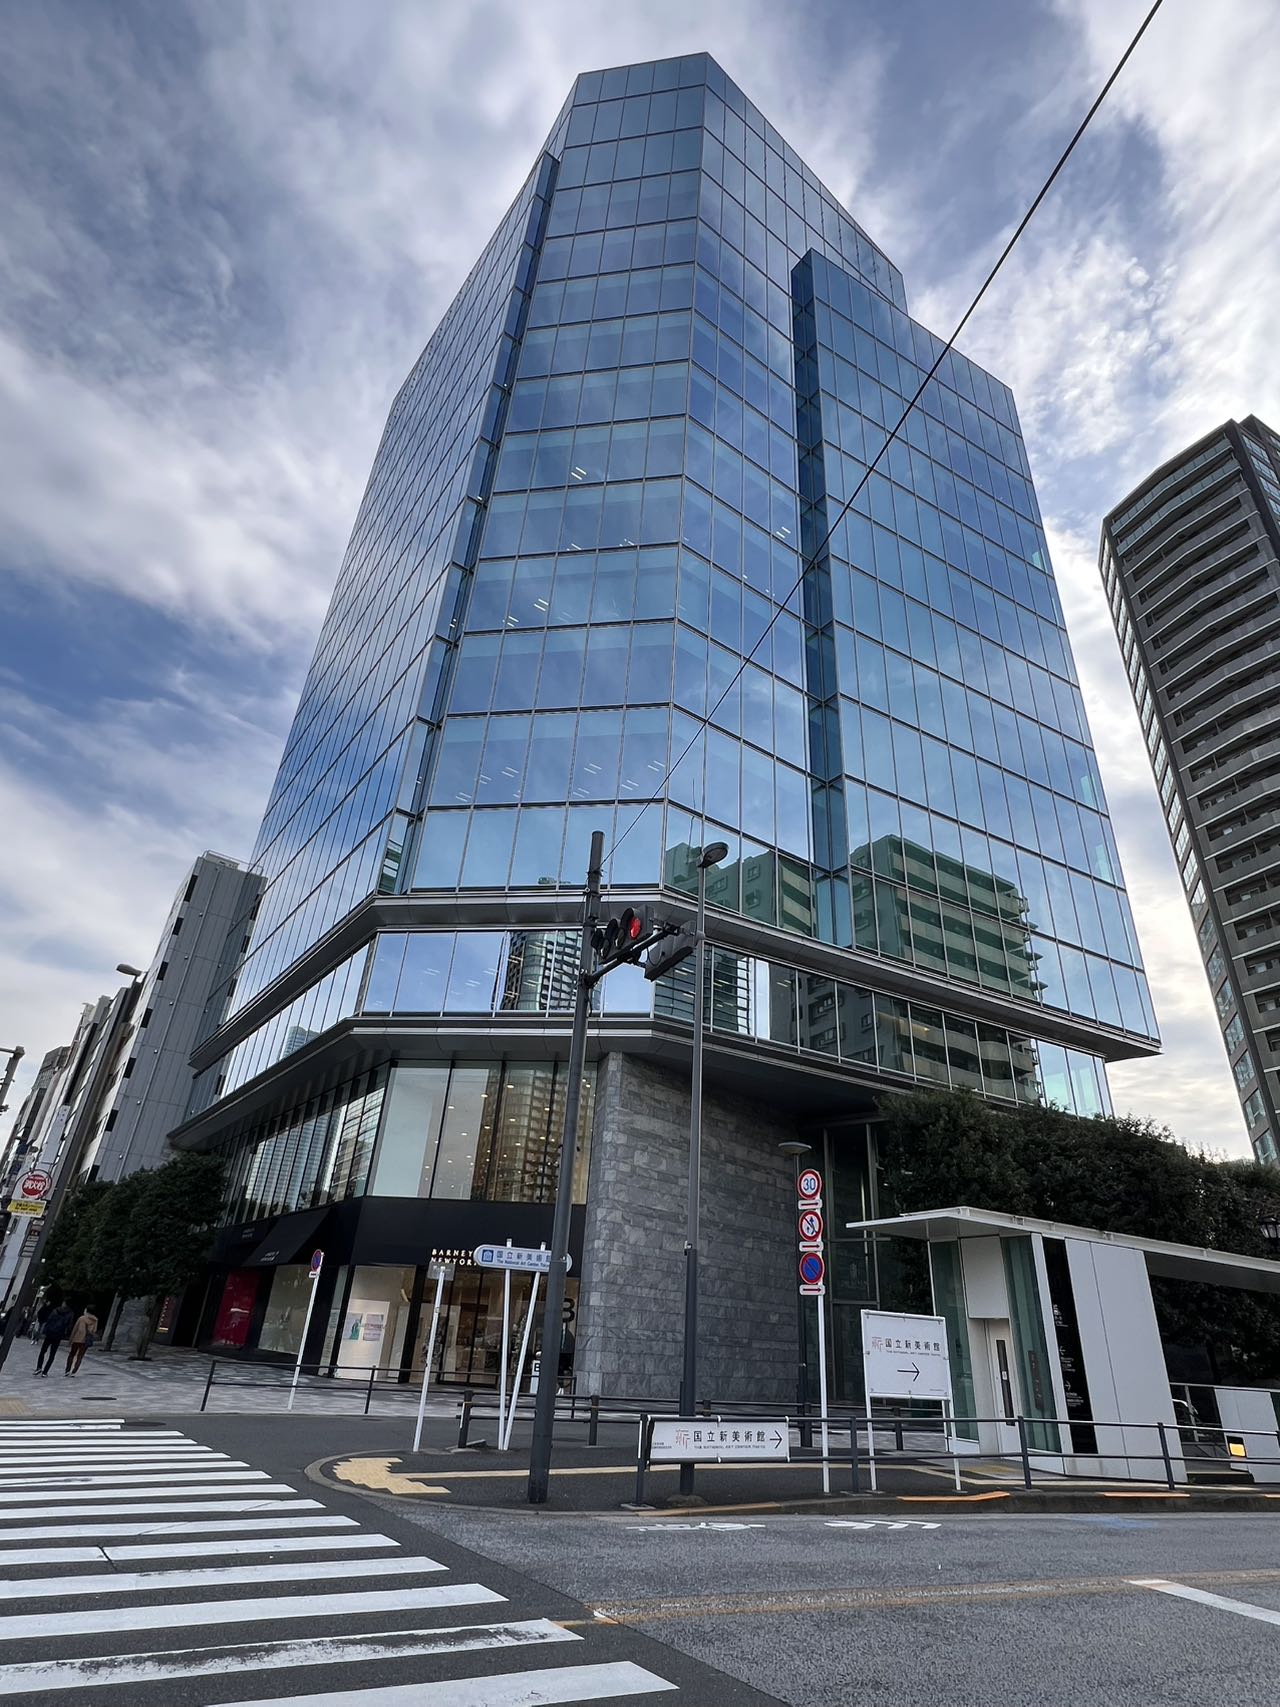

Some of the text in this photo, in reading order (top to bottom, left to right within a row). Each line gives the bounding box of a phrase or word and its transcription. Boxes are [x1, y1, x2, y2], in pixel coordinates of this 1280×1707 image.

[803, 1178, 817, 1191] 30
[431, 1248, 474, 1258] BARNEY
[885, 1338, 940, 1352] 国立新美術館
[693, 1430, 766, 1443] 国立新美術館
